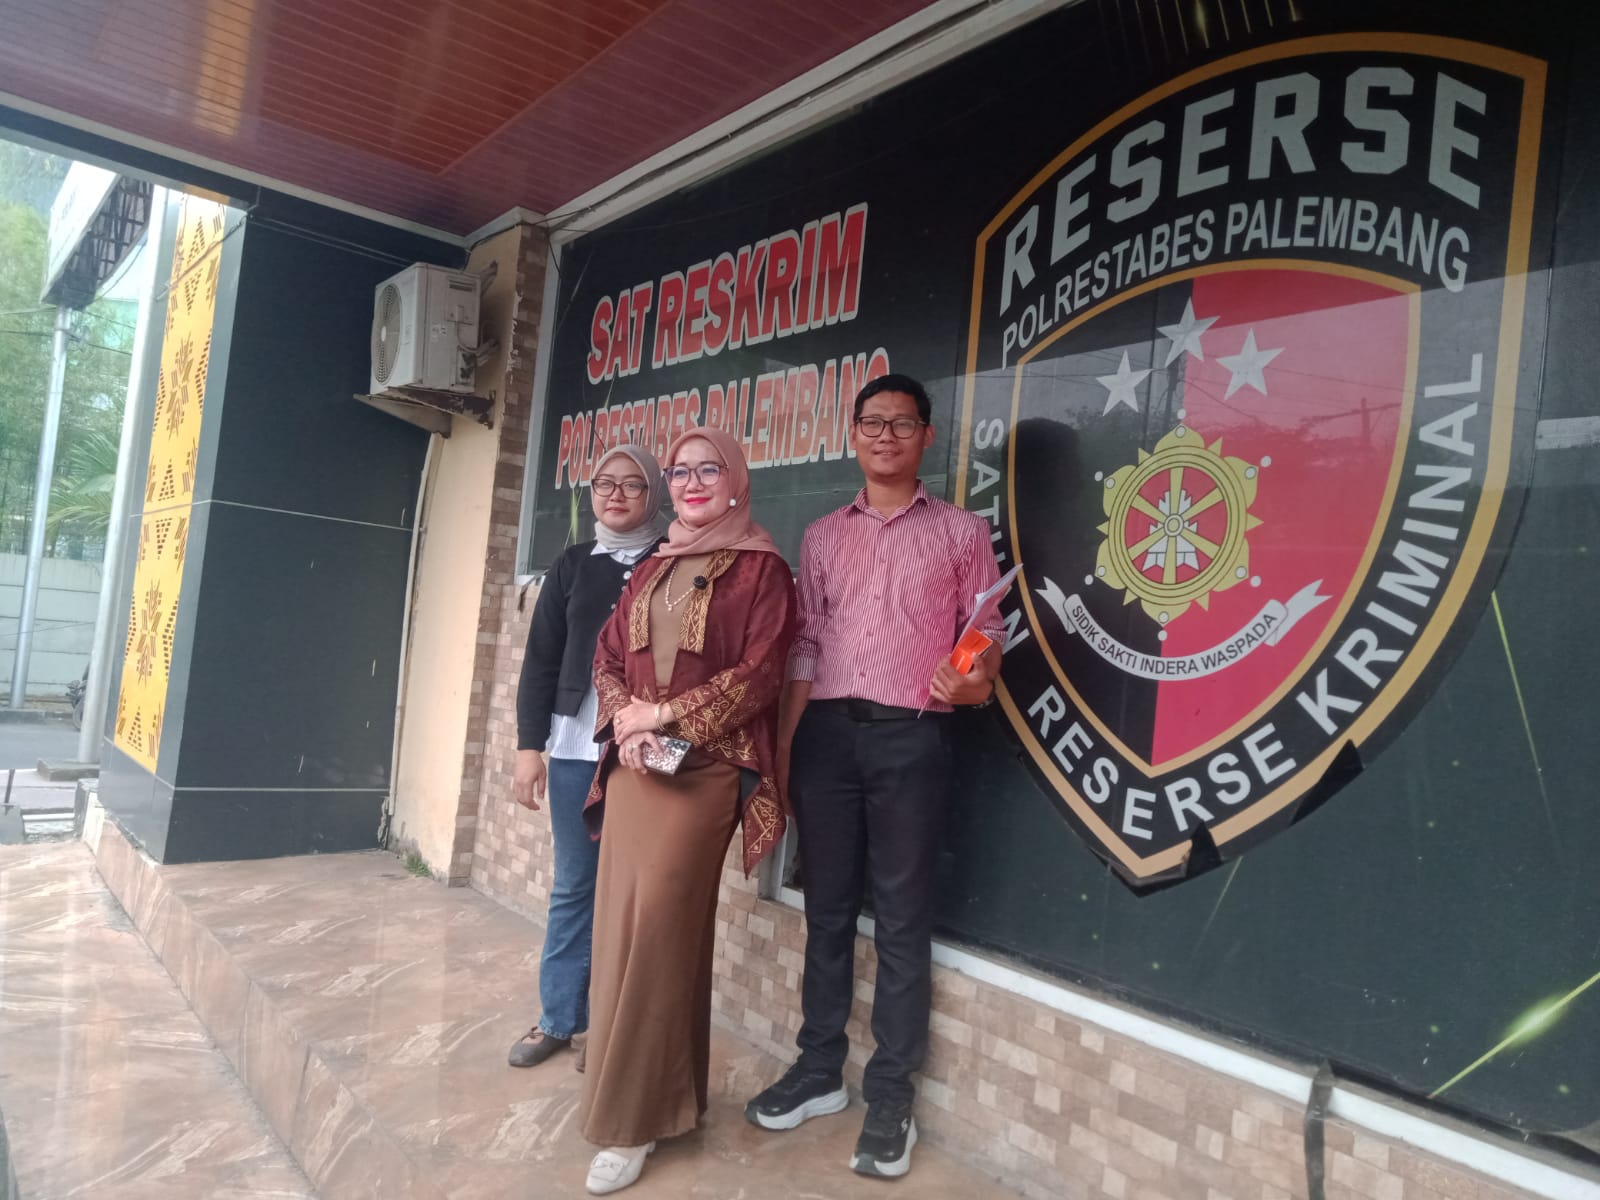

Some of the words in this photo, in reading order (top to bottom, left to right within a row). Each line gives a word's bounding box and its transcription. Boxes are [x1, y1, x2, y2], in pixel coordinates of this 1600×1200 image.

[999, 66, 1487, 317] RESERSE
[587, 281, 653, 384] SAT
[652, 202, 868, 369] RESKRIM
[1002, 209, 1214, 370] POLRESTABES
[1224, 196, 1471, 293] PALEMBANG
[970, 418, 1030, 655] SATN
[1028, 685, 1296, 840] RESERSE
[1296, 353, 1483, 735] KRIMINAL
[1072, 605, 1100, 644] SIDIK
[1098, 637, 1137, 668] SAKTI
[1140, 658, 1199, 675] INDERA
[1201, 613, 1277, 670] WASPADA
